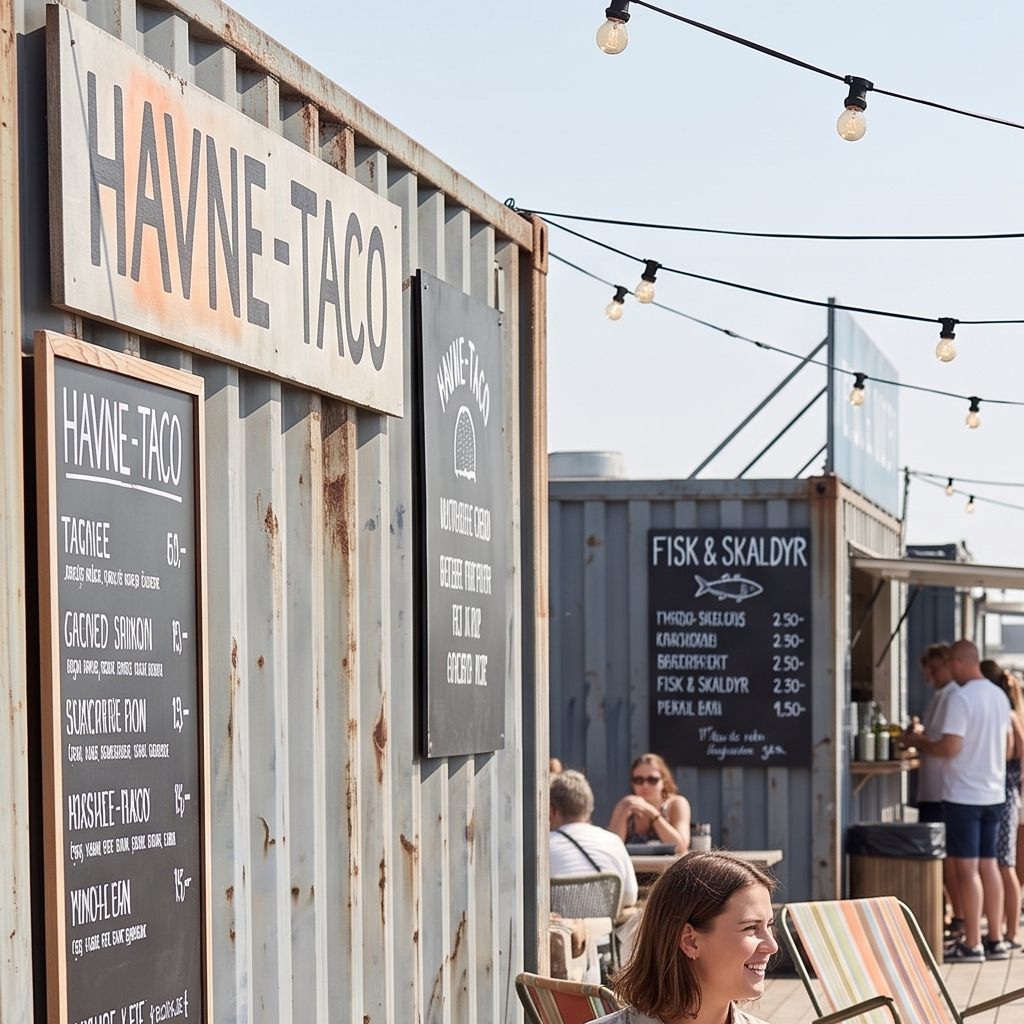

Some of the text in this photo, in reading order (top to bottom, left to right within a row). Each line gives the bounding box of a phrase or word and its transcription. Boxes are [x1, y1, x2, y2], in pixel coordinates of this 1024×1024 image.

[86, 69, 388, 373] HAVNE-TACO
[63, 386, 182, 486] HAVNE-TACO
[653, 535, 808, 567] FISK & SKALDYR
[656, 675, 684, 693] FISK
[698, 675, 749, 694] SKALDYR
